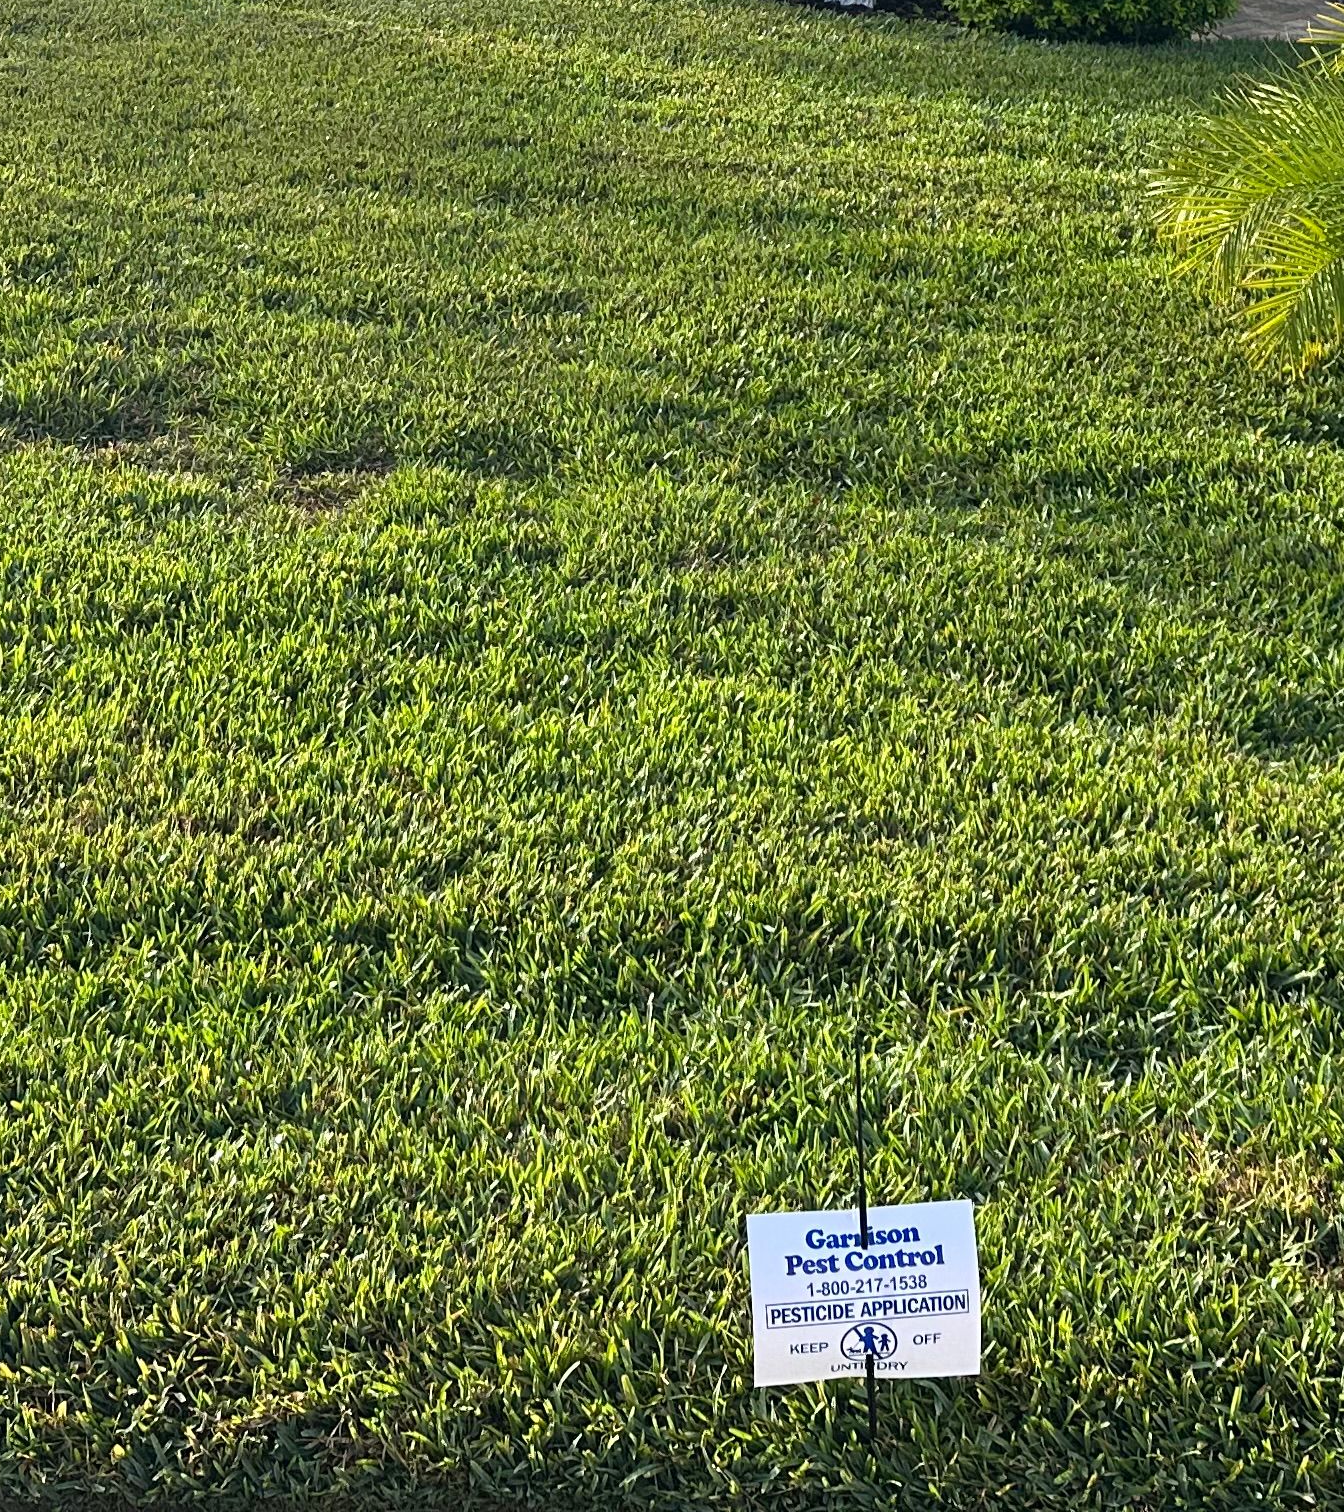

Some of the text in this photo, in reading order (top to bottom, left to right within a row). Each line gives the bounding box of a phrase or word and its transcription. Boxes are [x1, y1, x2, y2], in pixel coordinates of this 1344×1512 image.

[785, 1245, 945, 1276] Pest Control
[806, 1274, 928, 1297] 1-800-217-1538
[771, 1294, 966, 1324] PESTICIDE APPLICATION
[789, 1333, 942, 1355] KEEP OFF
[831, 1361, 908, 1372] UNTI DRY
